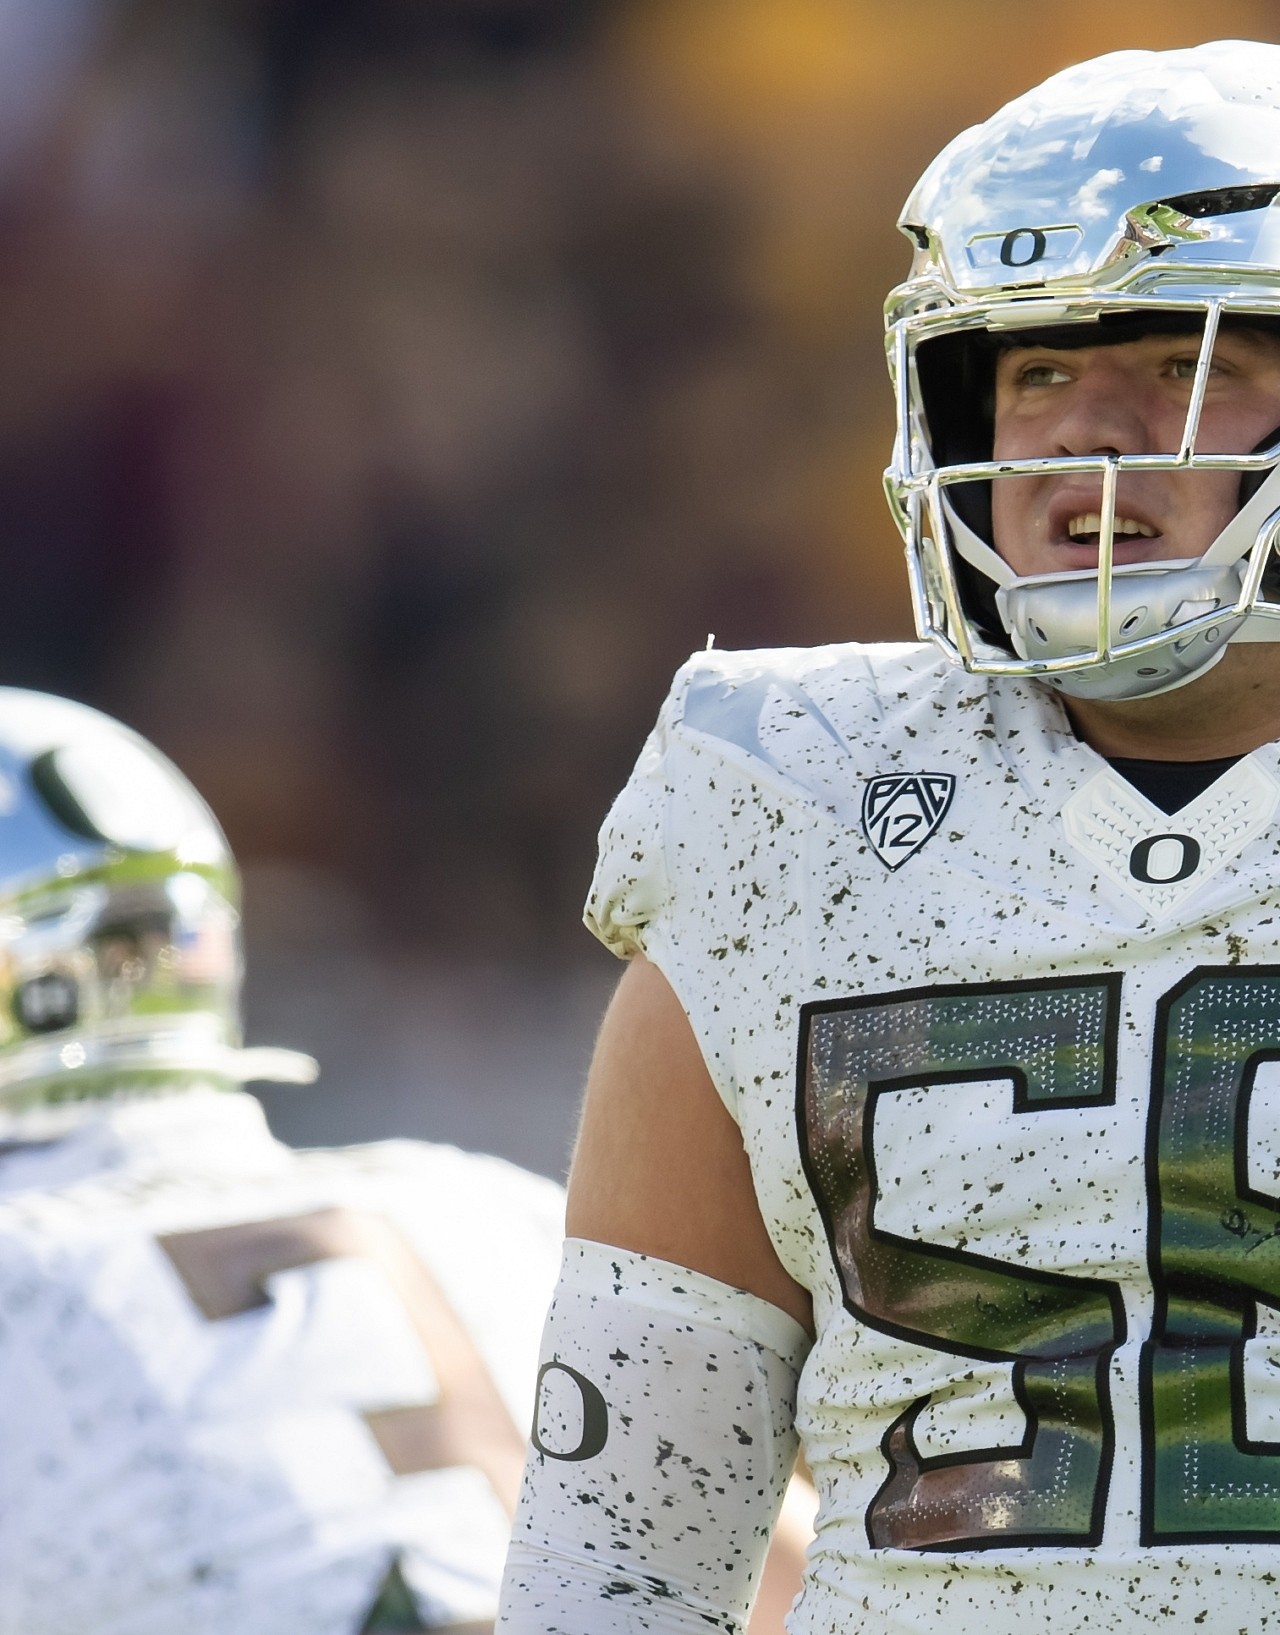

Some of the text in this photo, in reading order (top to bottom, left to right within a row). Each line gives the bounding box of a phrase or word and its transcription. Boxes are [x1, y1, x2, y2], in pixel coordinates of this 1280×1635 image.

[1000, 227, 1046, 267] O
[867, 777, 948, 830] PAC
[878, 813, 923, 848] 12
[1129, 833, 1201, 884] O
